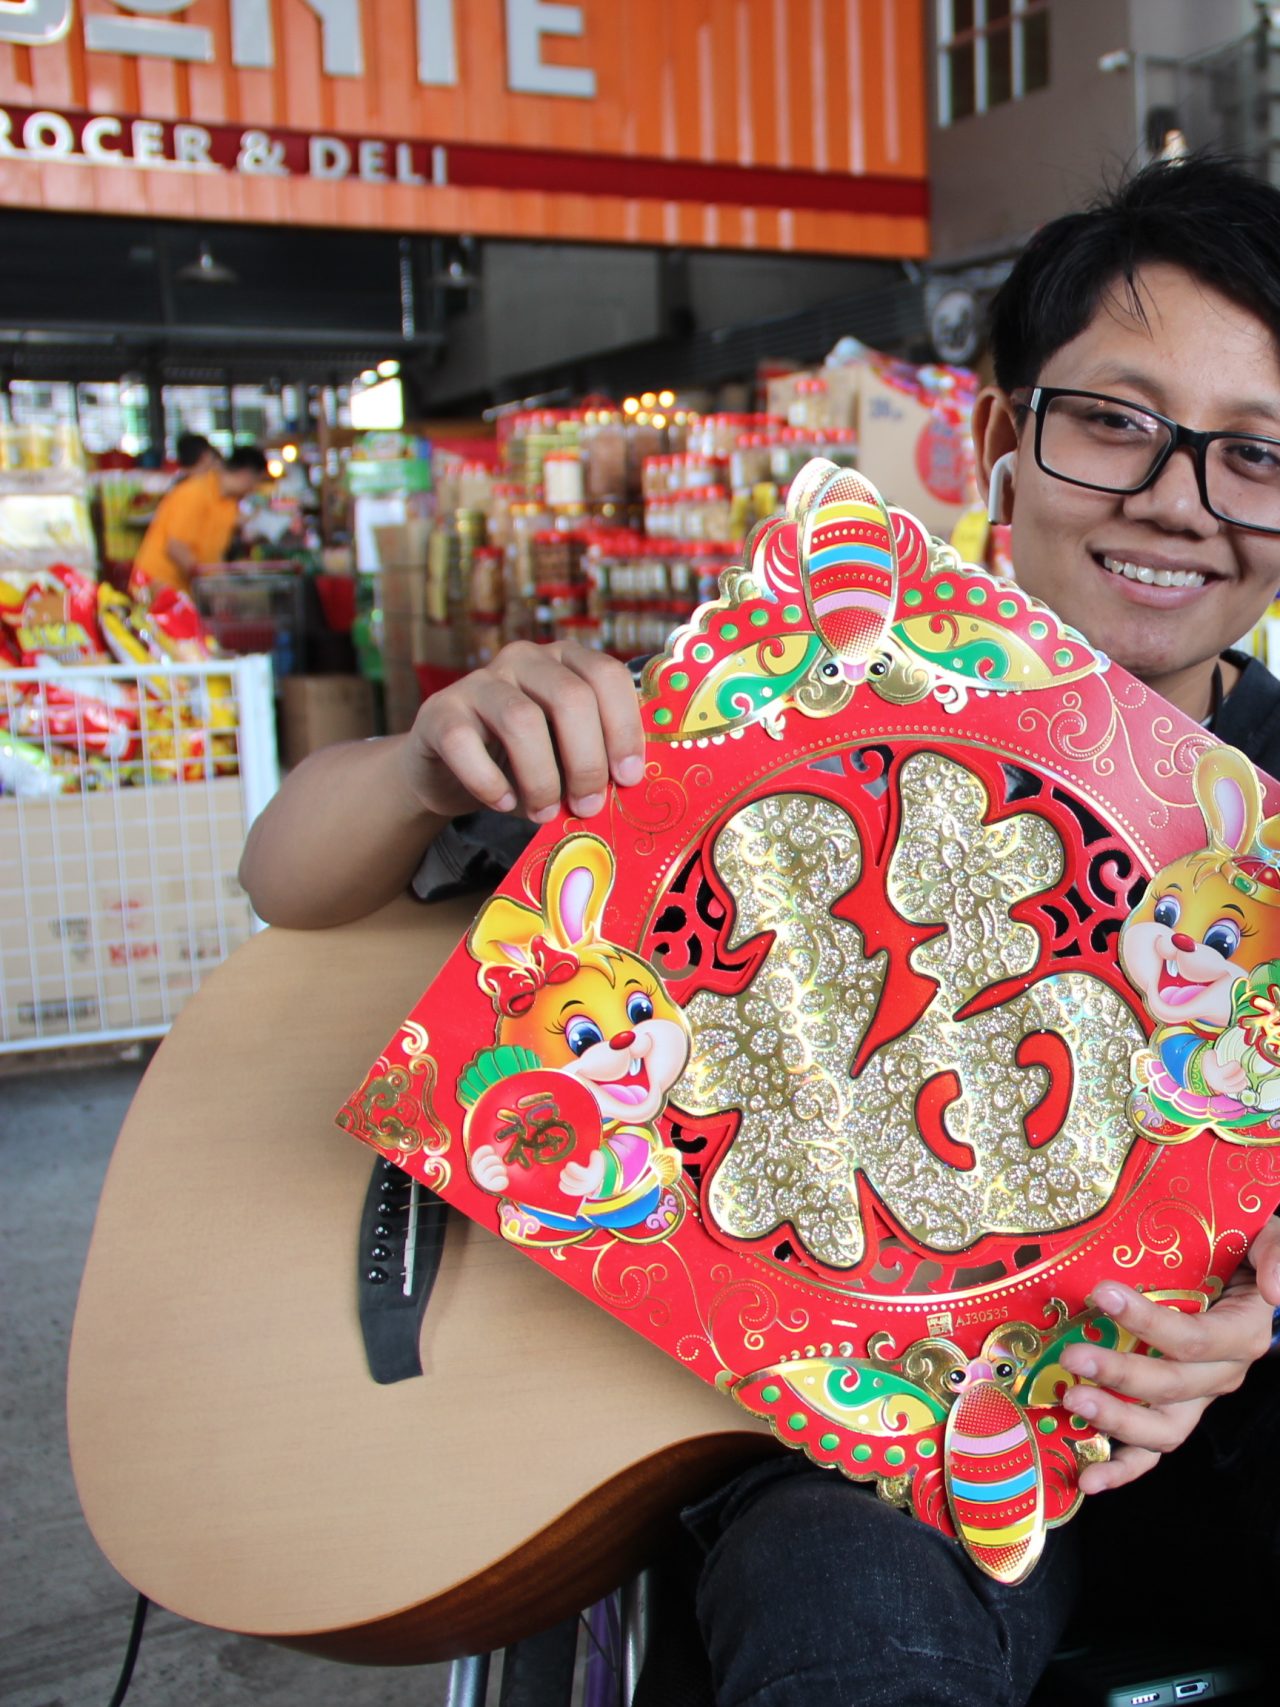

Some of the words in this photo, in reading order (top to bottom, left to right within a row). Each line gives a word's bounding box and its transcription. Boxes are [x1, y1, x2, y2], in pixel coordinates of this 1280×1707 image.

[236, 130, 289, 176] &
[307, 136, 448, 186] DELI
[496, 1091, 577, 1169] 福
